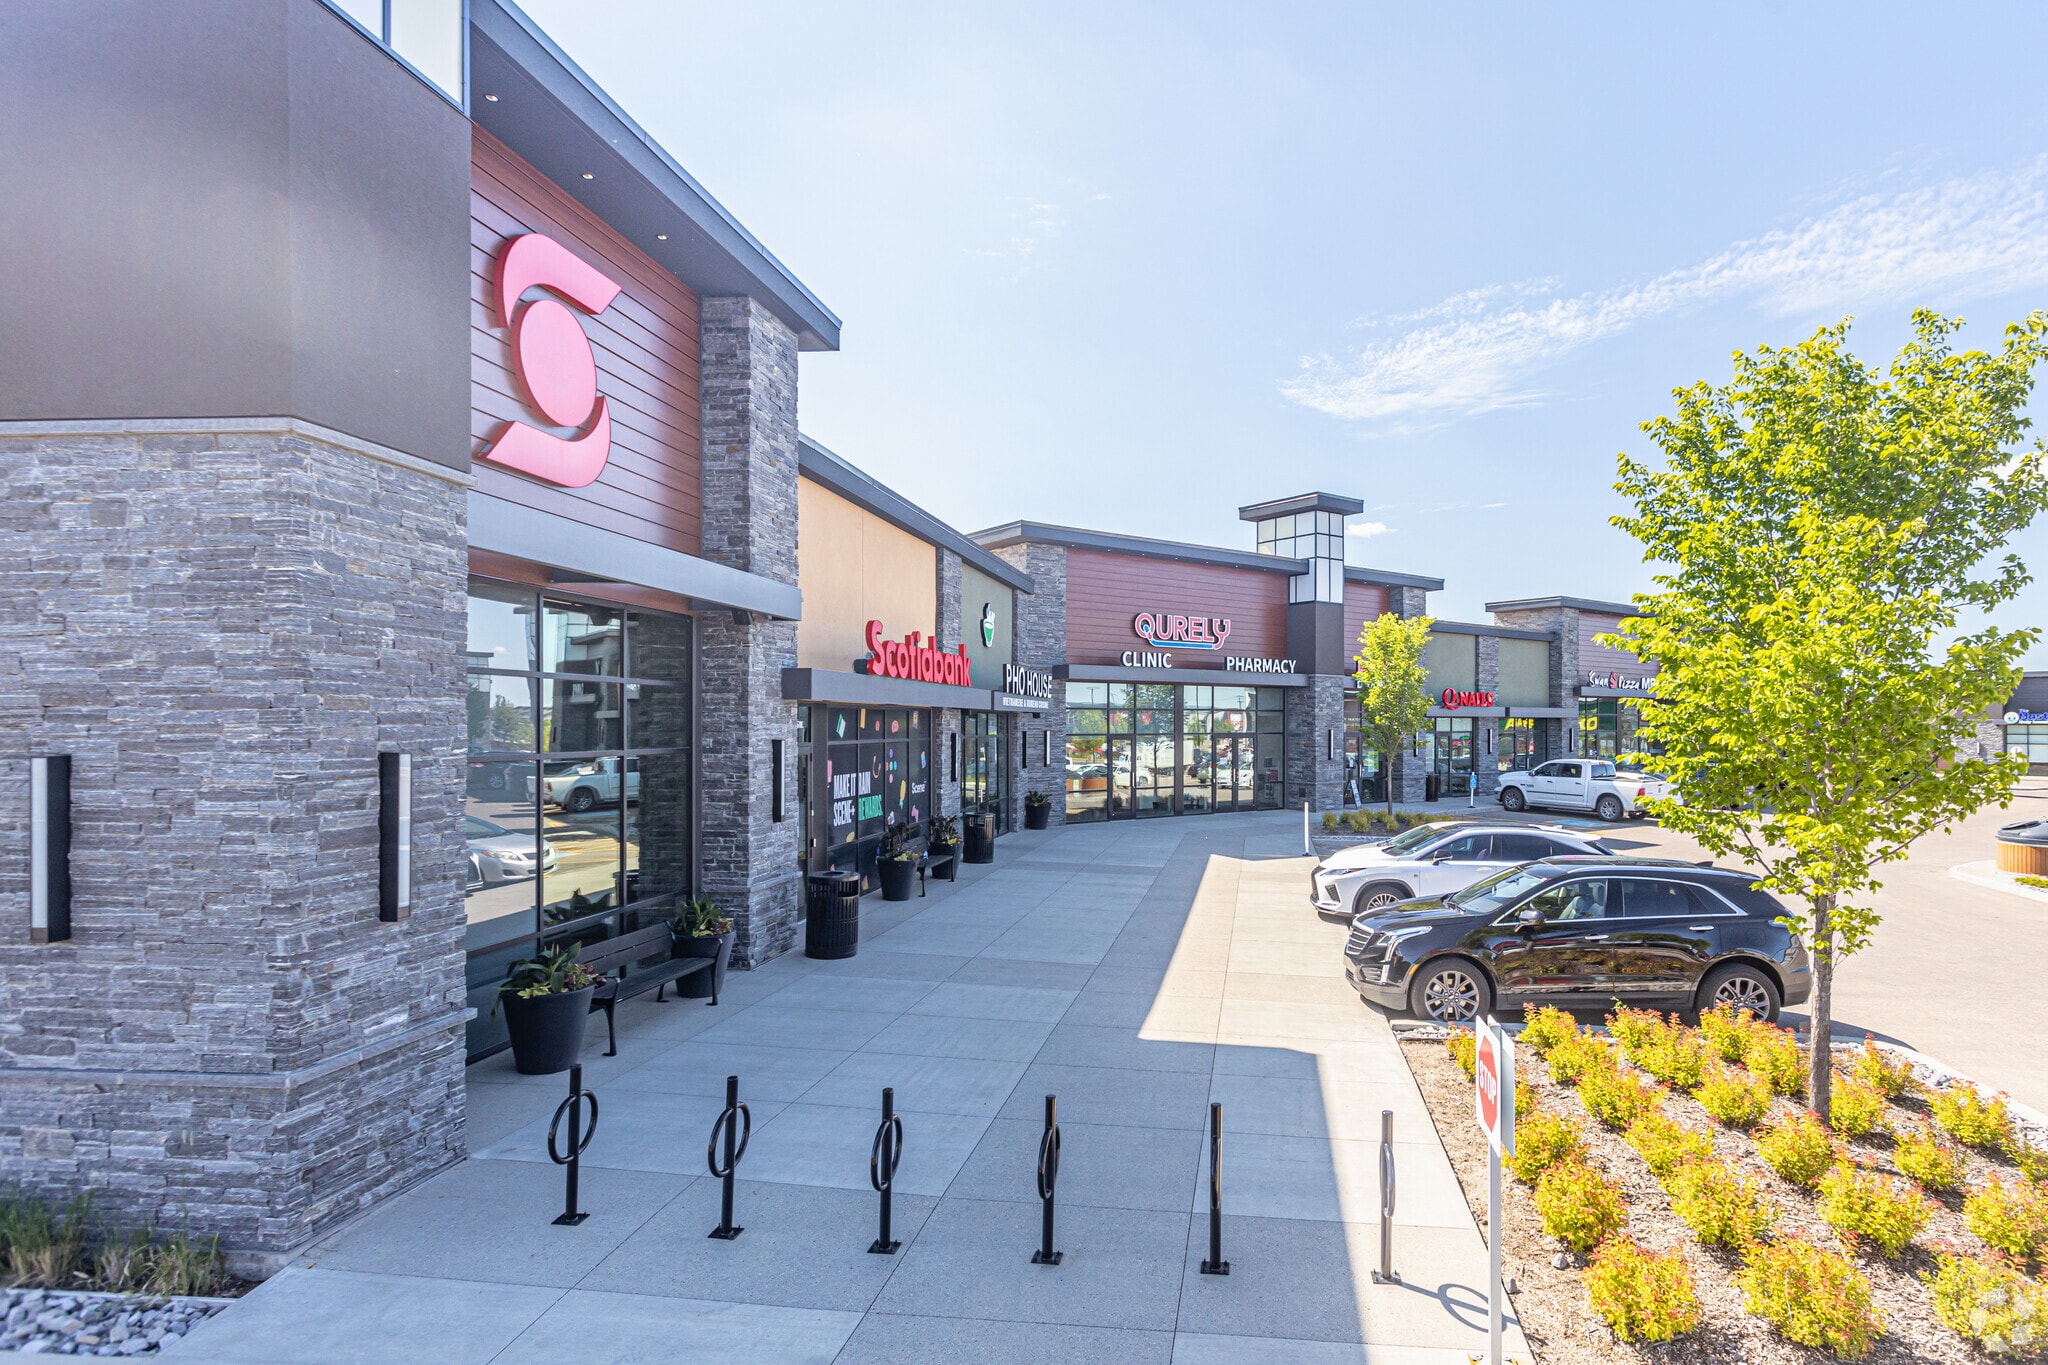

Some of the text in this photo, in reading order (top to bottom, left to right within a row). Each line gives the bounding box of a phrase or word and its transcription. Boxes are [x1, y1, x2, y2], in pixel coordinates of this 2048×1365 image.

[1135, 613, 1231, 650] QURELY
[866, 620, 972, 687] Scotiabank
[1122, 651, 1172, 668] CLINIC
[1226, 657, 1297, 674] PHARMACY
[1006, 663, 1052, 698] PHO HOUSE
[1618, 676, 1640, 690] Pizza
[833, 773, 851, 799] MAKE
[851, 772, 857, 796] IT
[1480, 1060, 1497, 1105] STOP
